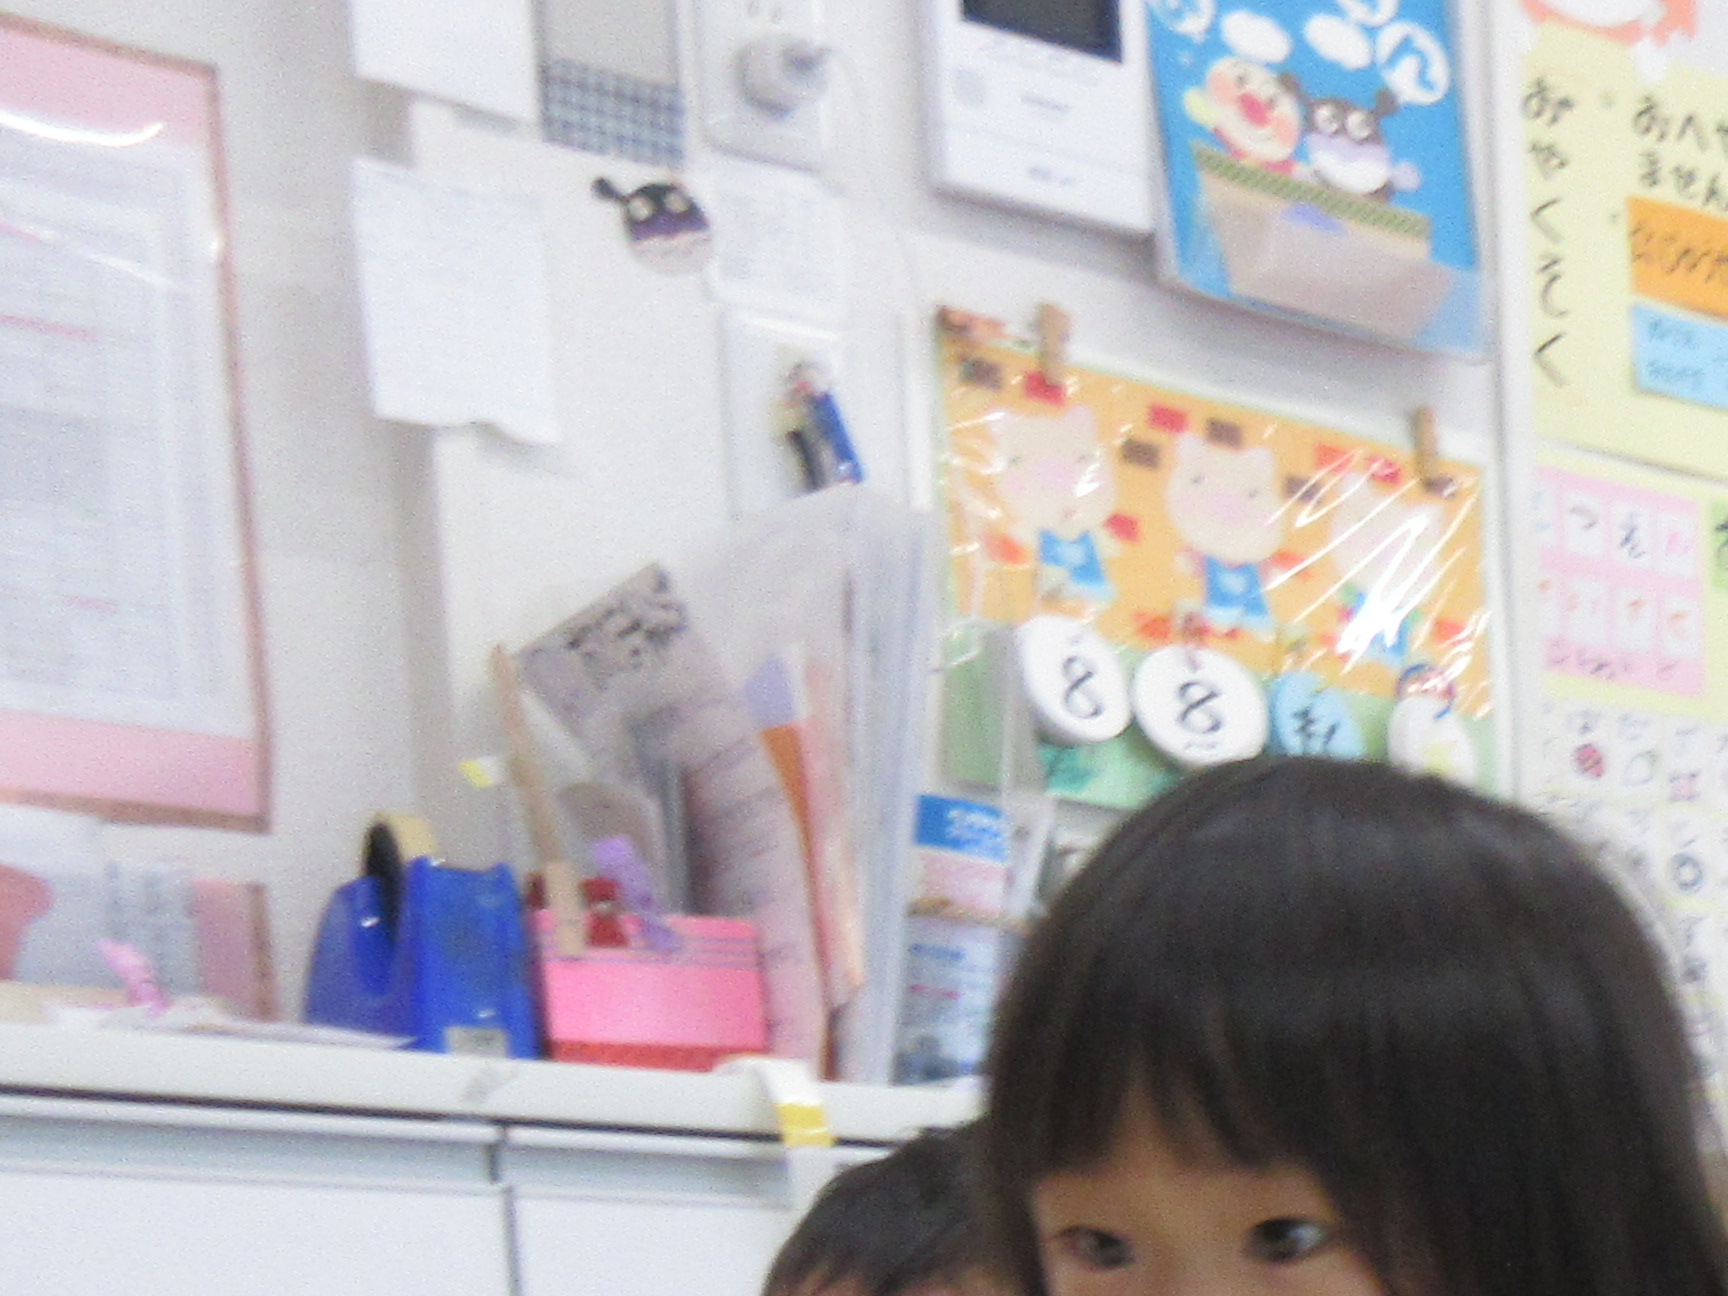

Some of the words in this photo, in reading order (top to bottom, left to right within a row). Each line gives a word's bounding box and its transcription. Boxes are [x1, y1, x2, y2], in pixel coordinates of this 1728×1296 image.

[1522, 75, 1575, 388] おやくそく
[1060, 655, 1096, 719] 8
[1177, 679, 1222, 736] 8
